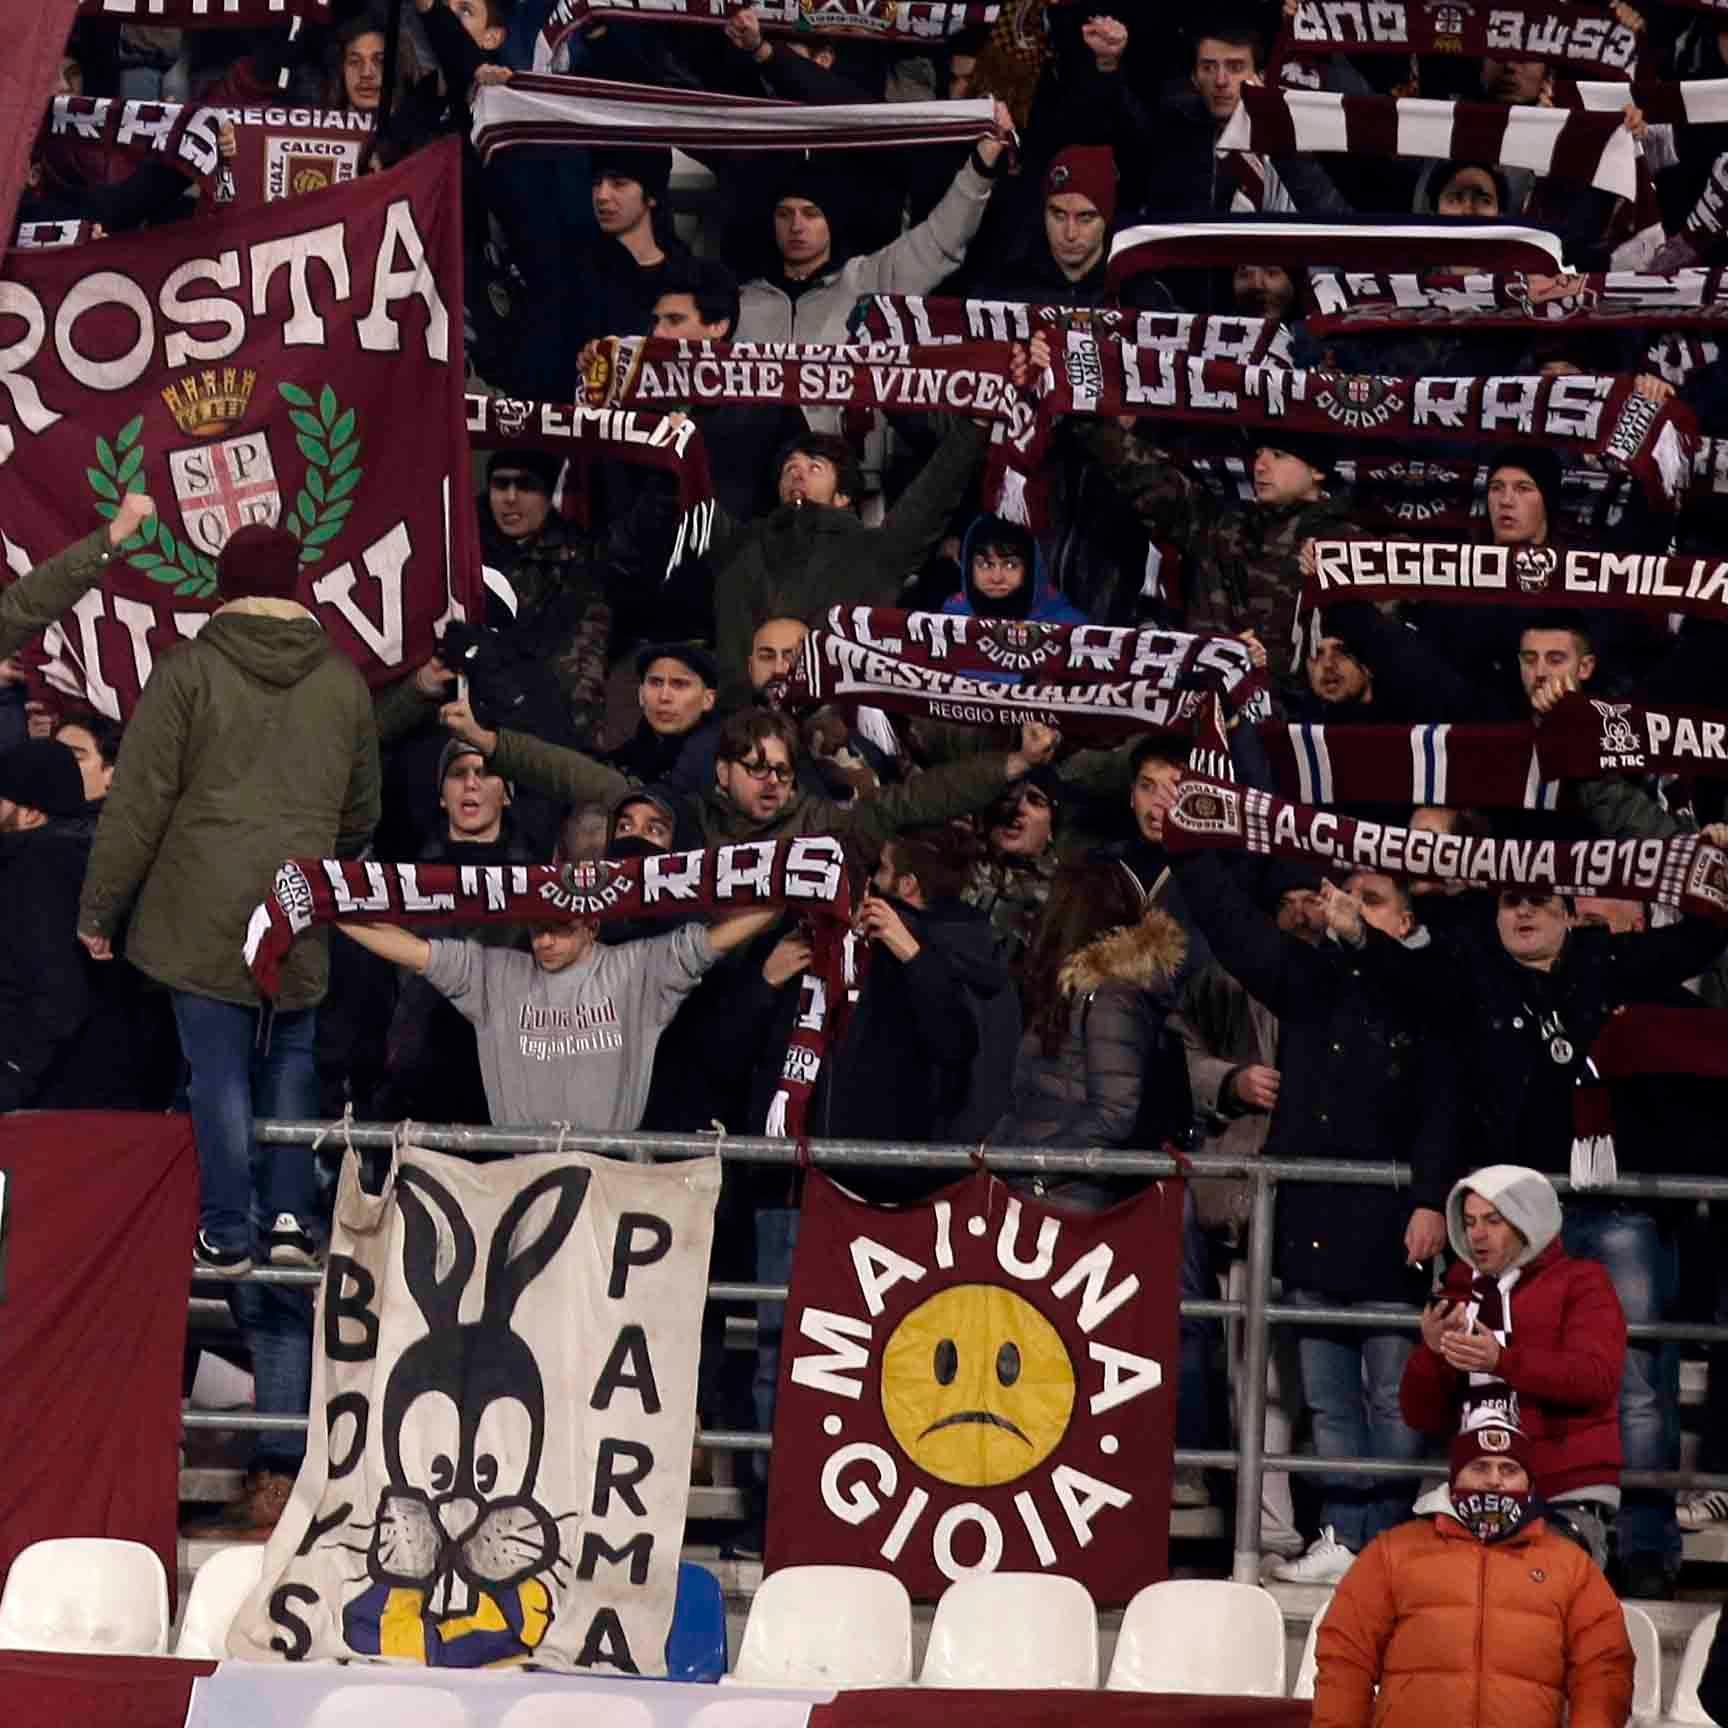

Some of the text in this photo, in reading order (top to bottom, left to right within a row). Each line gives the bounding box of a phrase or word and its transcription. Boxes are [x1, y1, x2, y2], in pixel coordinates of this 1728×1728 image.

[280, 141, 346, 156] CALCIO
[635, 357, 785, 402] ANCHE
[798, 365, 855, 403] SE
[540, 402, 697, 460] EMILIA
[1313, 390, 1407, 429] QUADRE
[187, 444, 258, 492] S P
[1315, 540, 1728, 602] REGGIO EMILIA
[928, 701, 994, 722] REGGIO
[1599, 754, 1646, 769] PR TBC
[1273, 818, 1666, 888] A.C. REGGIANA 1919
[538, 872, 635, 914] QUADRE
[792, 1198, 1162, 1406] MAI UNA
[574, 1211, 673, 1675] PARMA
[820, 1441, 1133, 1583] GIOIA
